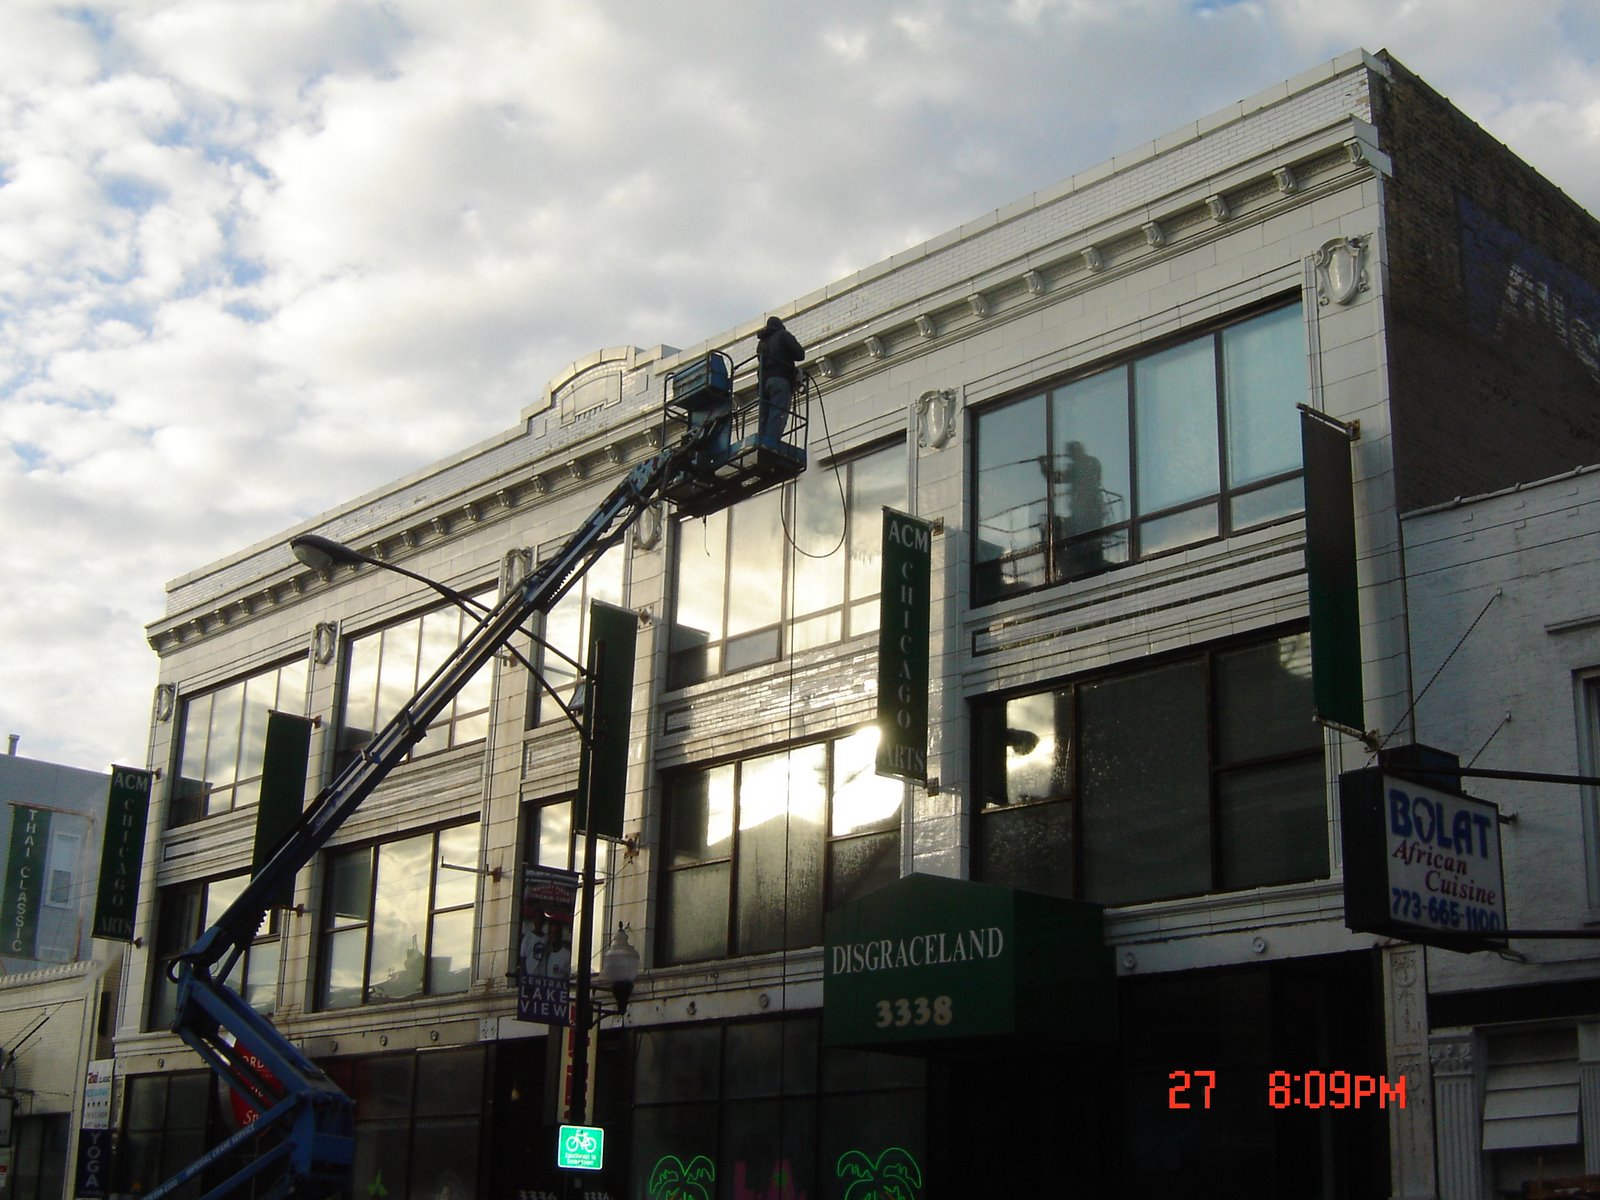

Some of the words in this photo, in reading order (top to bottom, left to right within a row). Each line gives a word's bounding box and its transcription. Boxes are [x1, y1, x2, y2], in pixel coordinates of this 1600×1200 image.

[888, 520, 929, 553] ACM
[895, 560, 914, 730] CHICAGO
[884, 744, 926, 776] ARTS
[114, 771, 149, 792] ACM
[24, 809, 39, 858] THAI
[1388, 788, 1492, 860] BOLAT
[111, 797, 136, 908] CHICAGO
[1392, 839, 1468, 875] African
[1424, 869, 1497, 906] Cuisine
[12, 866, 32, 952] CLASSIC
[98, 915, 134, 937] ARTS
[1391, 887, 1500, 932] 773-665-1100
[832, 927, 1004, 975] DISGRACELAND
[520, 975, 569, 991] CENTRAL
[520, 984, 568, 1003] LAKE
[520, 1000, 568, 1018] VIEW
[875, 994, 953, 1028] 3338
[86, 1132, 101, 1188] YOGA
